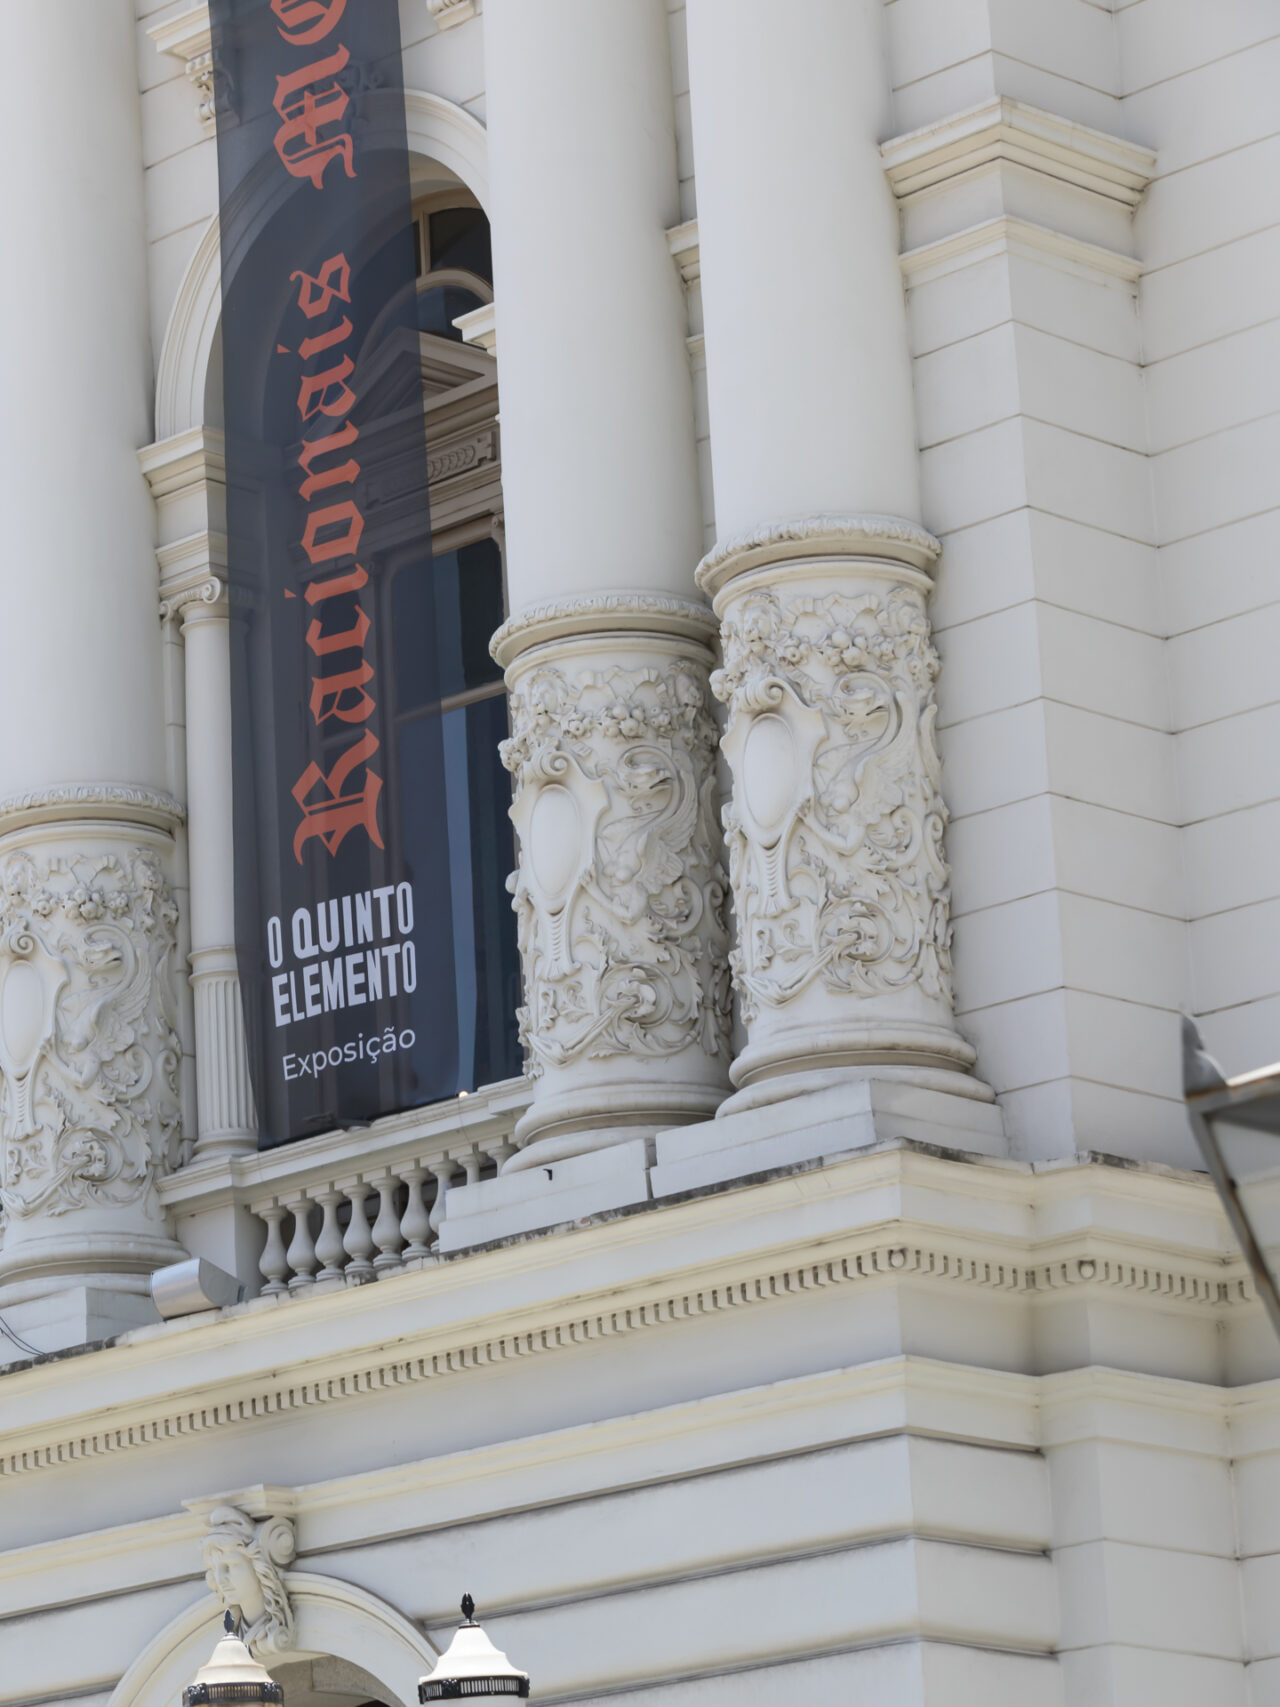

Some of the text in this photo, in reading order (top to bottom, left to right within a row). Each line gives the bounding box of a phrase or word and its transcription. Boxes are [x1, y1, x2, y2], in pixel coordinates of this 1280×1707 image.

[277, 252, 385, 866] Racionais
[267, 881, 414, 969] O QUINTO
[271, 940, 417, 1028] ELEMENTO
[282, 1026, 417, 1081] Exposição
